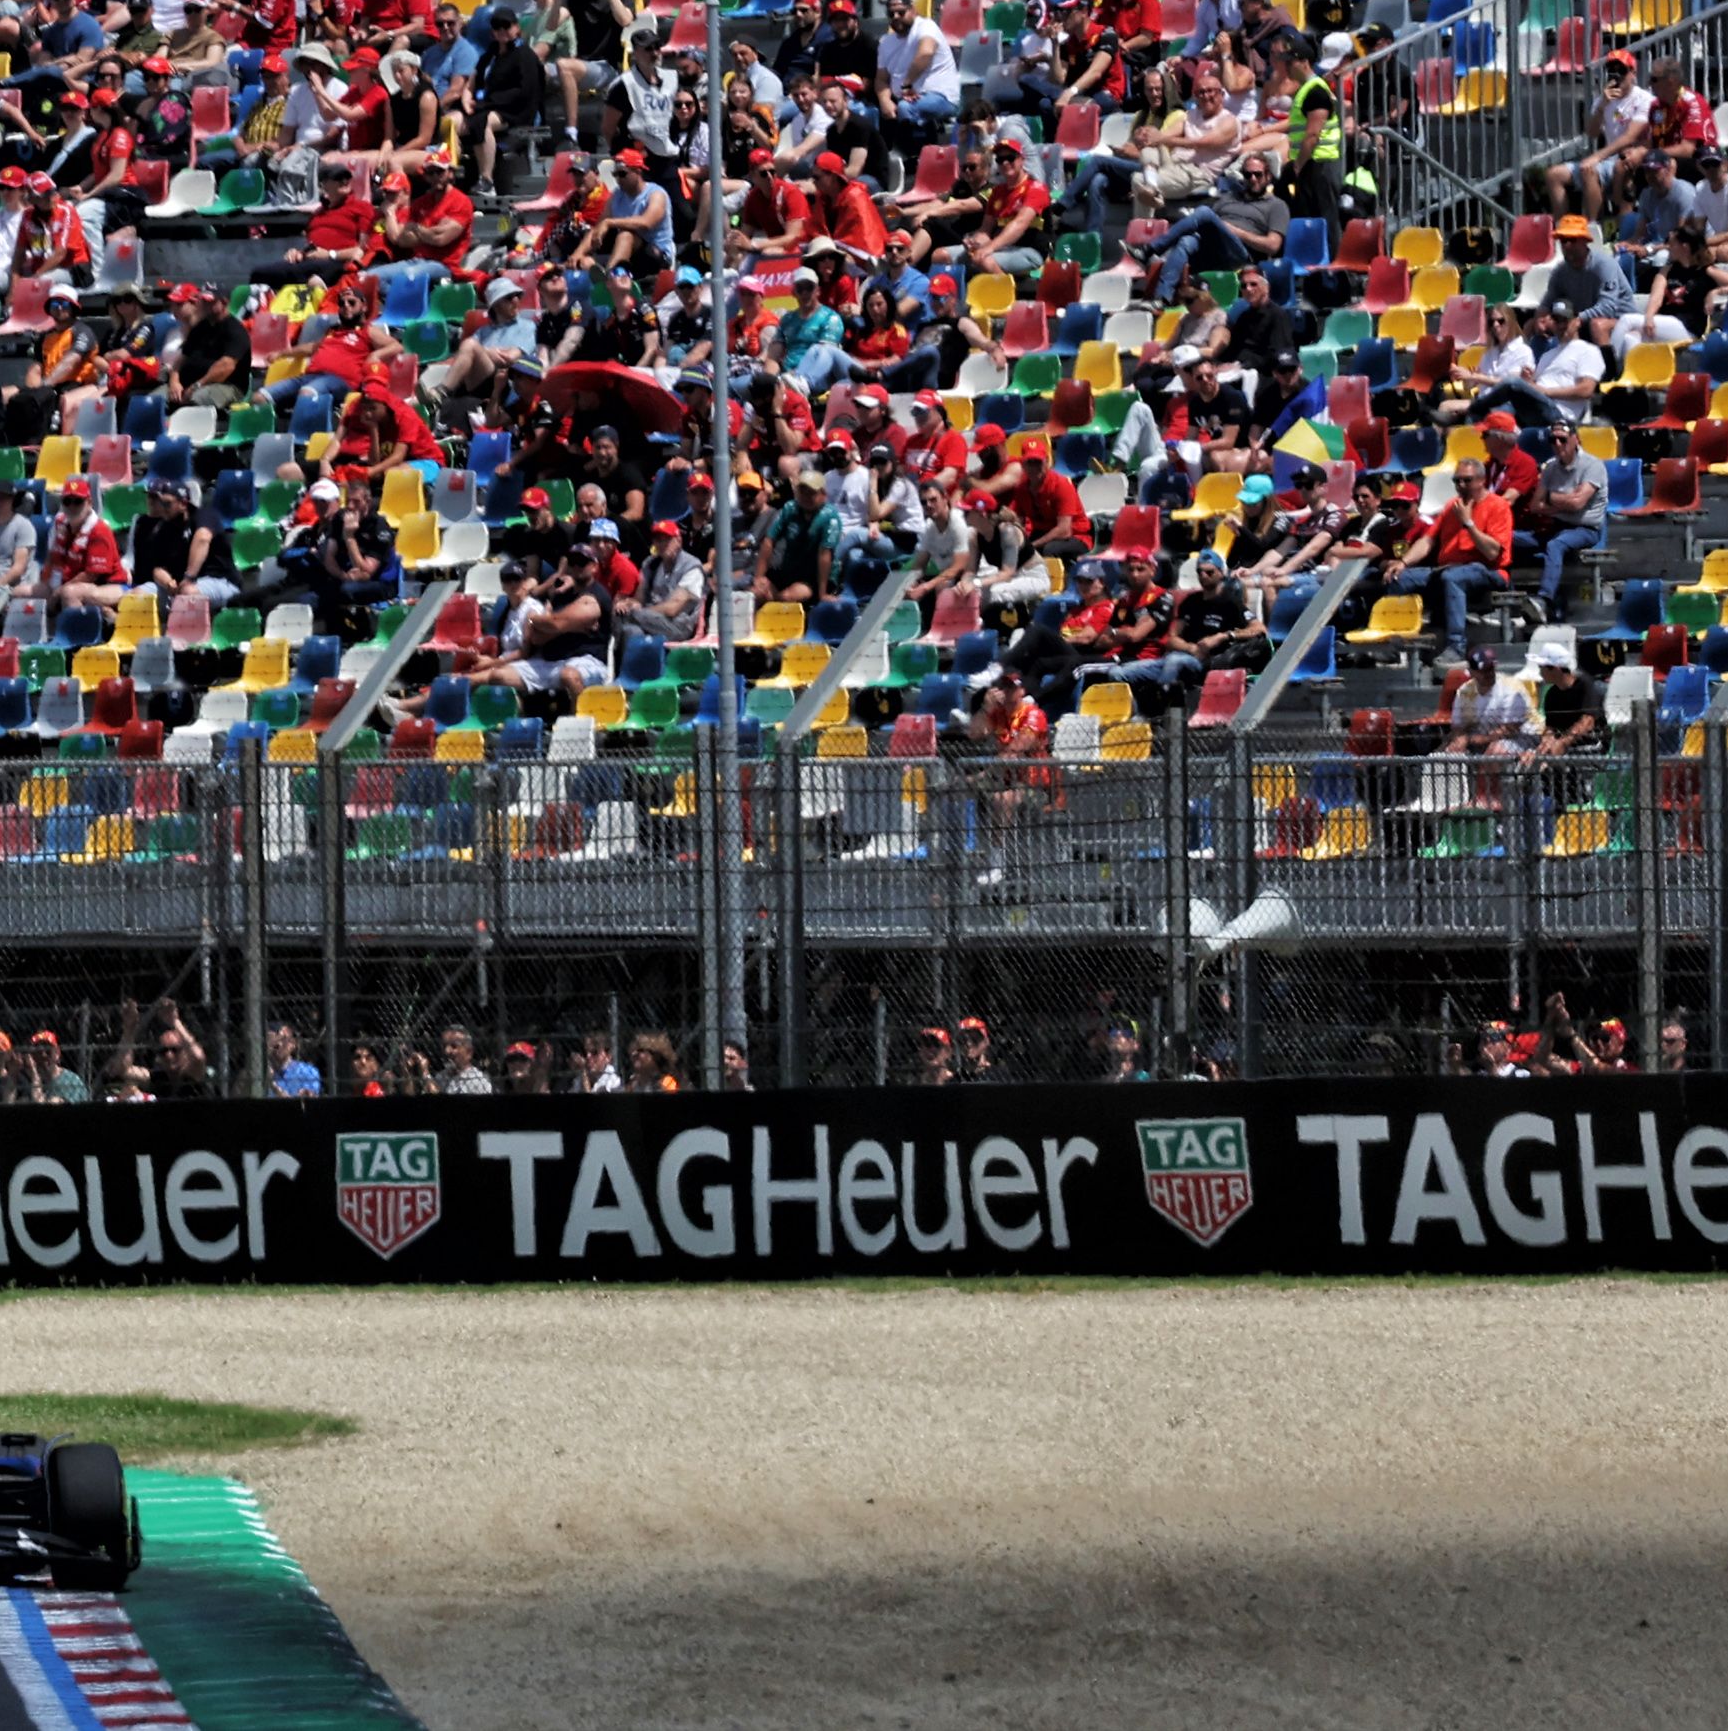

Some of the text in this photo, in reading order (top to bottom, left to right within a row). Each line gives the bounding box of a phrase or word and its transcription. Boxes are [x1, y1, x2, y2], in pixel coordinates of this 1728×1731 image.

[345, 1141, 427, 1179] TAG
[1147, 1127, 1236, 1167] TAG
[344, 1190, 433, 1247] HEUER
[1151, 1178, 1245, 1233] HEUER
